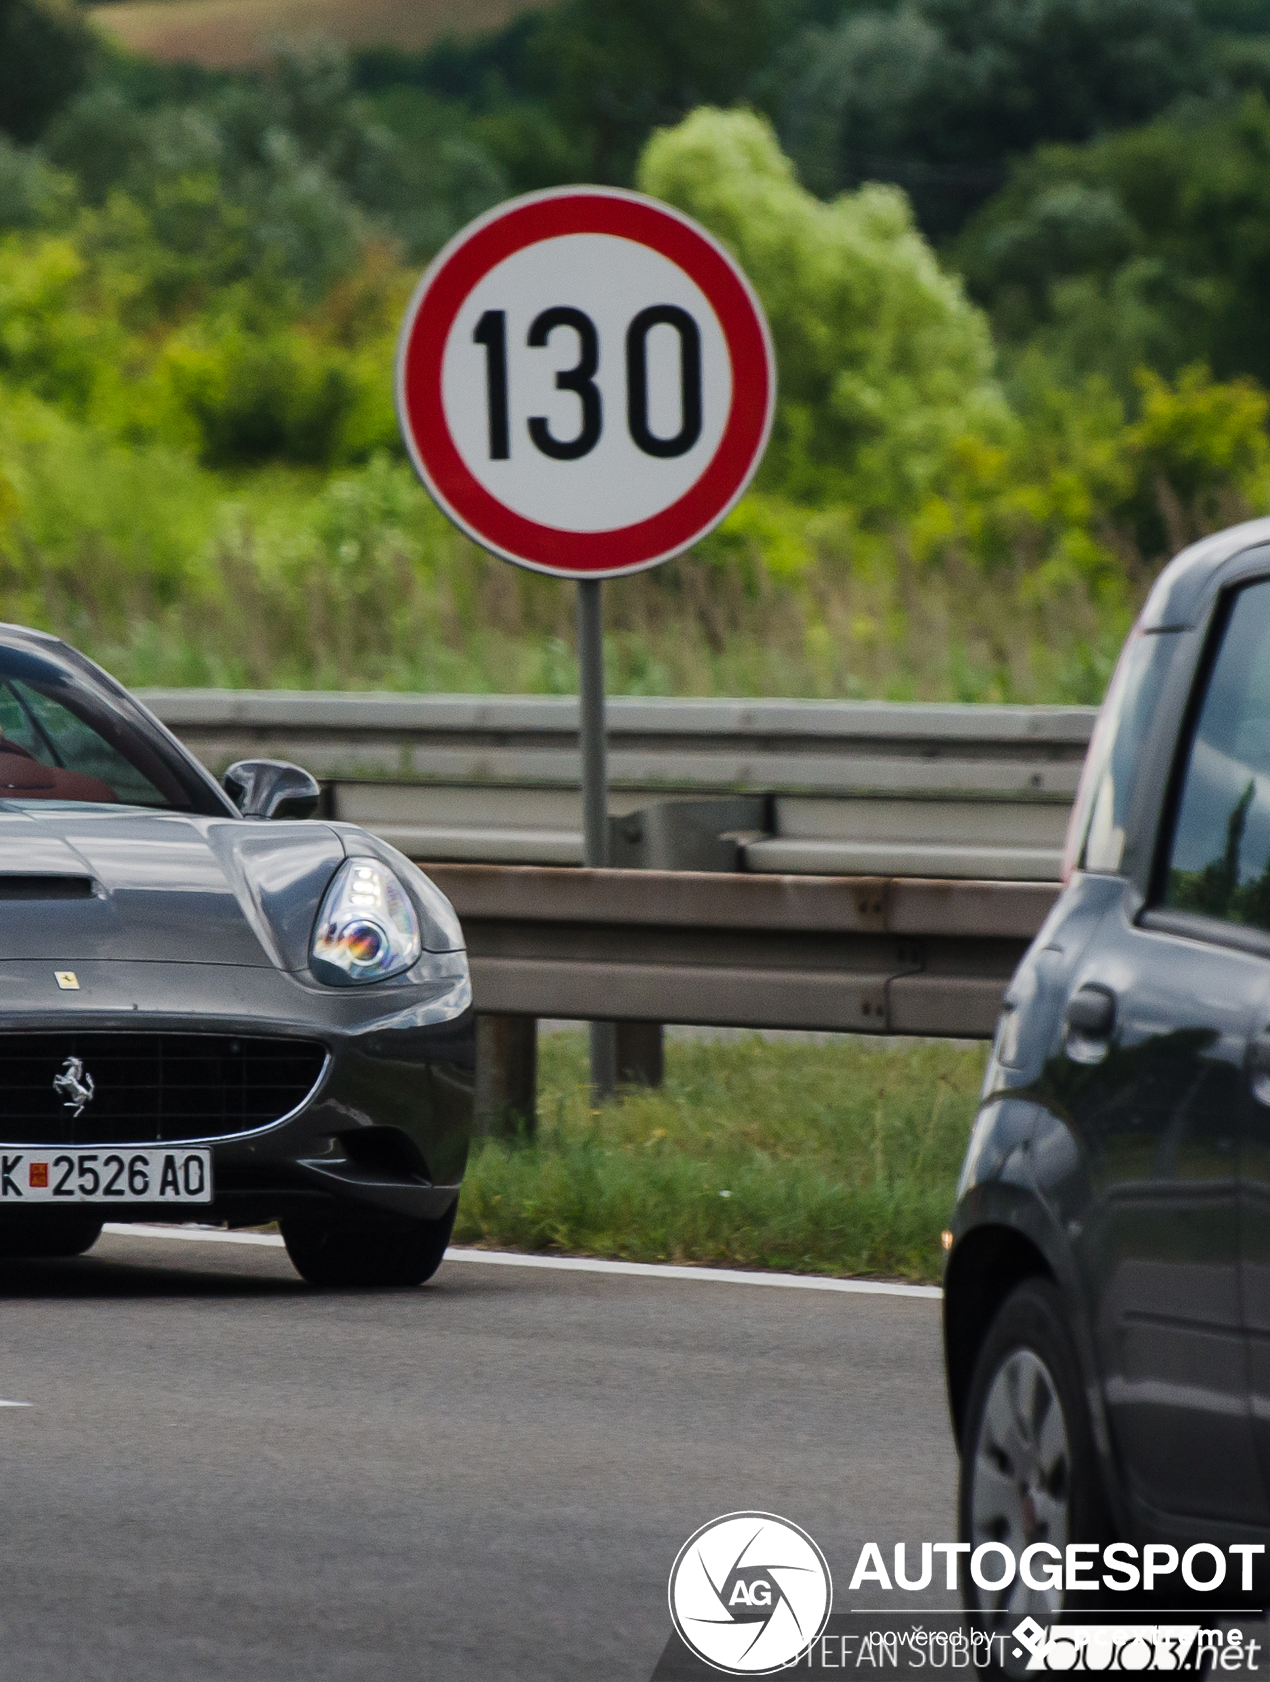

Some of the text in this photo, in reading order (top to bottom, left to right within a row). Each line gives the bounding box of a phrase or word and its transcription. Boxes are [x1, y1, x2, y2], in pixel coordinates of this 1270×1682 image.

[473, 304, 702, 460] 130
[52, 1155, 150, 1196] 2526
[159, 1155, 205, 1196] AO
